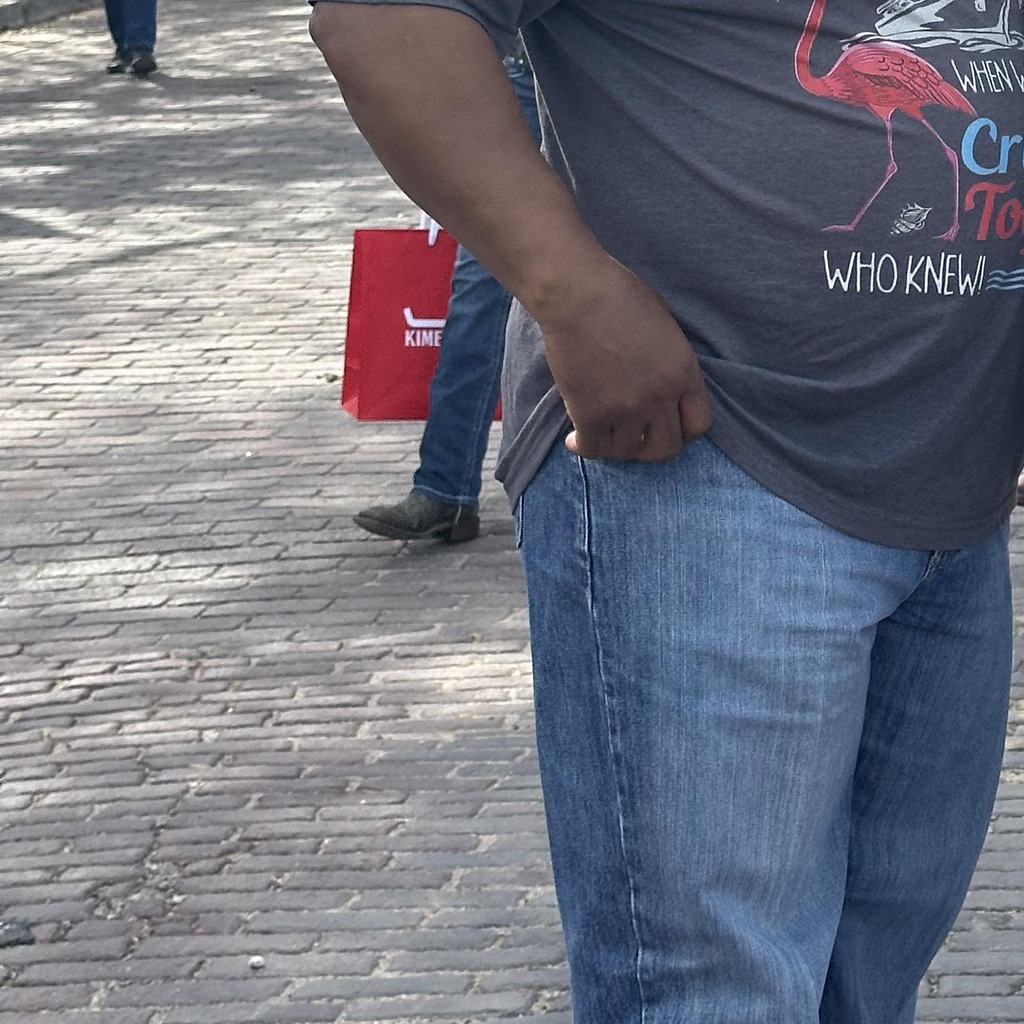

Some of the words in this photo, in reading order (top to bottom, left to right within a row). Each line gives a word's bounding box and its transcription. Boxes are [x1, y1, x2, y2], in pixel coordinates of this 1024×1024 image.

[951, 59, 1013, 93] WHEN
[822, 250, 898, 293] WHO
[404, 329, 443, 347] KIME
